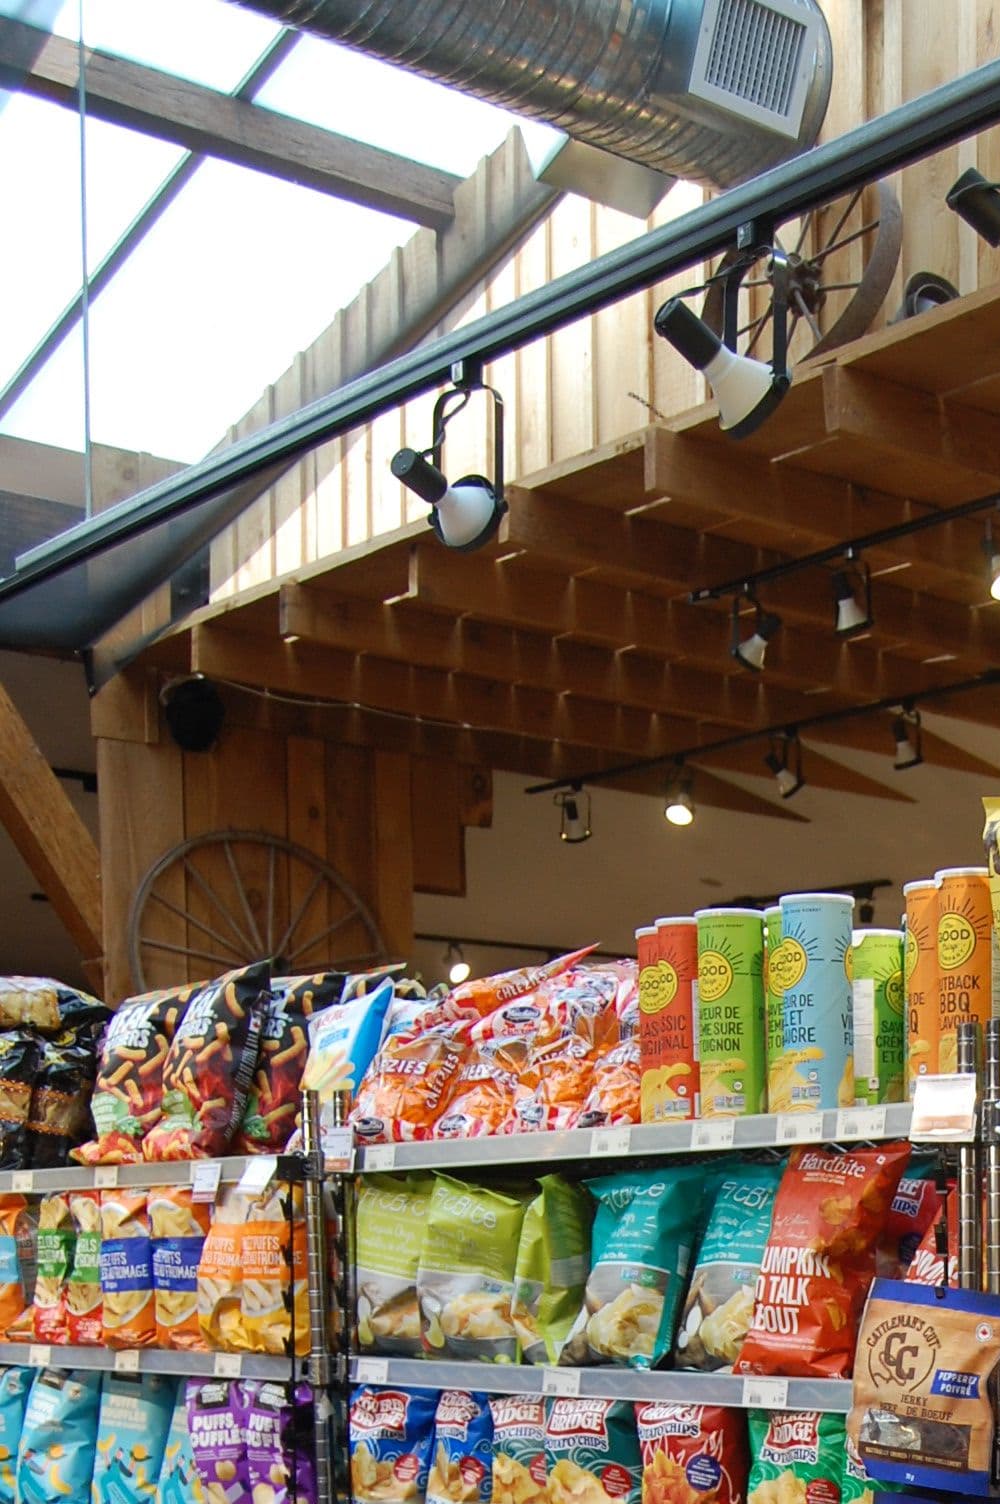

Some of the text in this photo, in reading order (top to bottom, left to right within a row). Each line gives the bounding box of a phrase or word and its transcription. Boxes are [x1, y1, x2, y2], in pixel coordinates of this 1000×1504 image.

[940, 992, 969, 1013] BBQ
[714, 1022, 744, 1035] SURE
[769, 1276, 809, 1307] TALK
[900, 1394, 928, 1407] JERKY
[906, 1406, 917, 1416] DE
